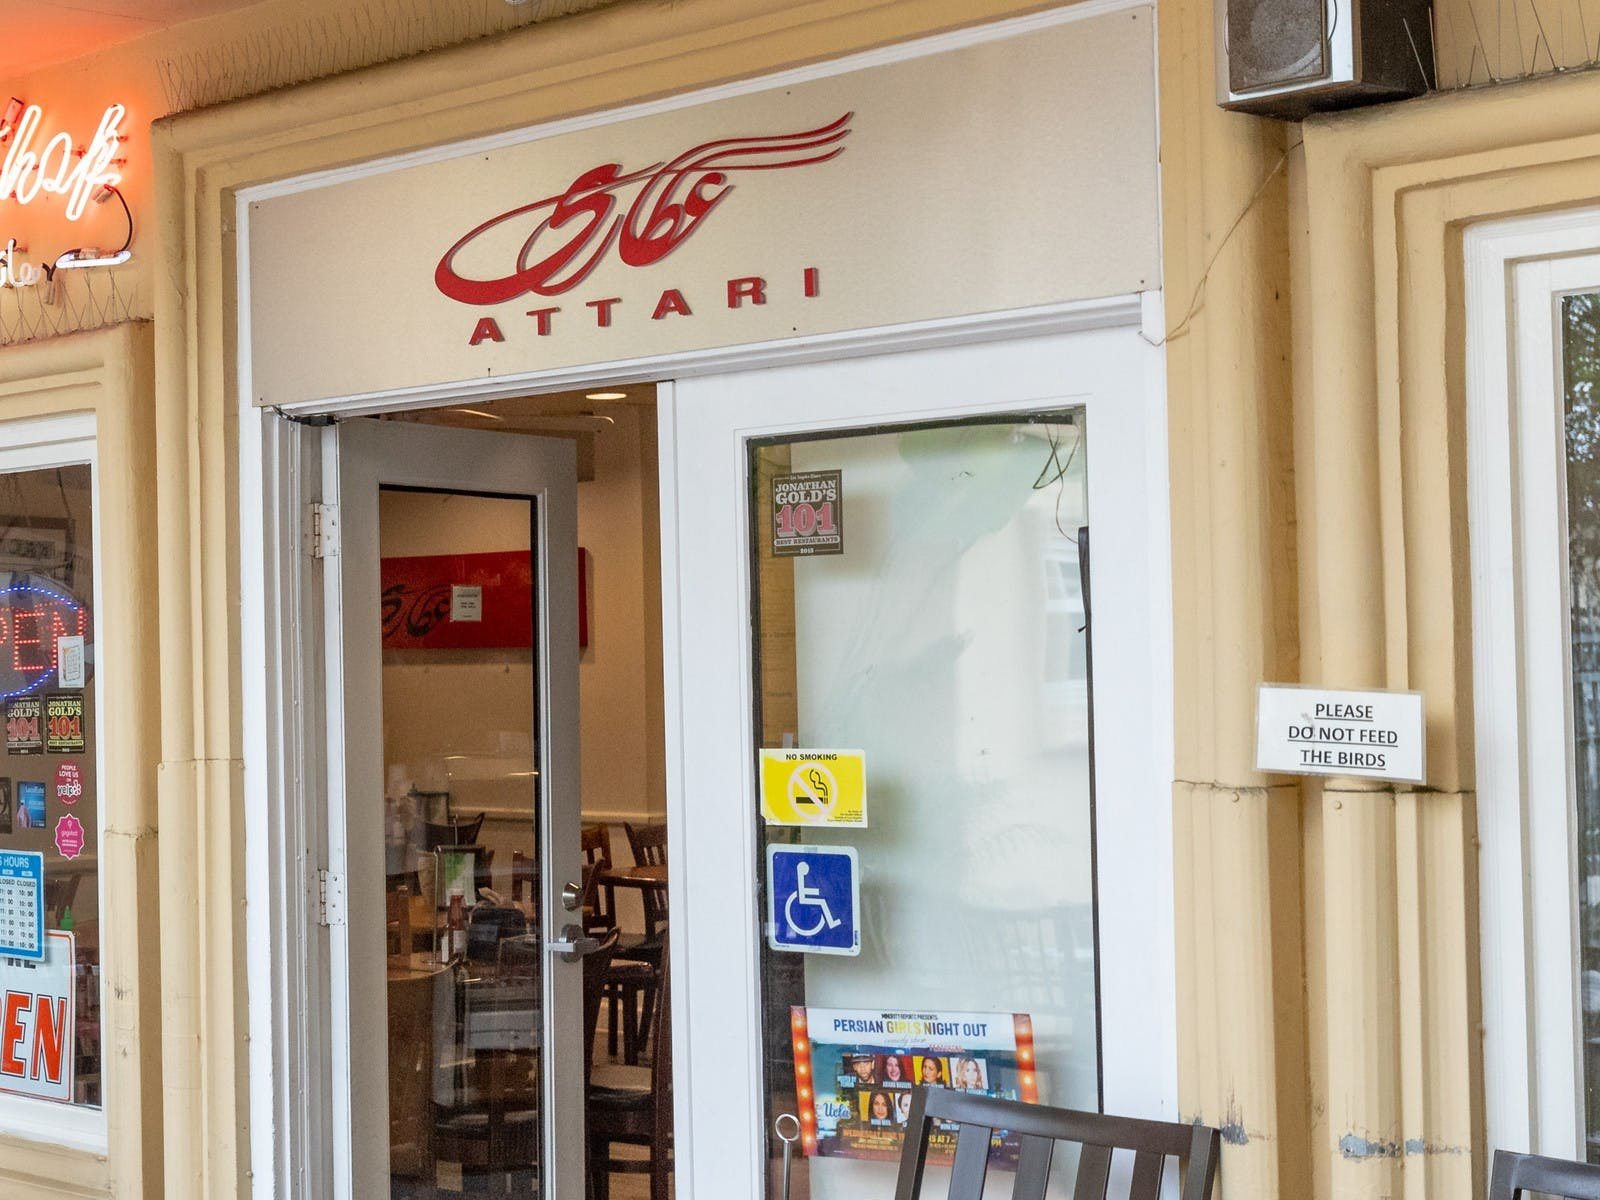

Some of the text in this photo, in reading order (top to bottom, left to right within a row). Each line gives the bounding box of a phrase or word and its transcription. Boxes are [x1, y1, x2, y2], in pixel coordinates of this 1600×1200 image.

[468, 267, 819, 346] ATTARI
[776, 480, 836, 492] JONATHAN
[776, 489, 837, 504] GOLD'S
[776, 501, 837, 537] 101
[8, 708, 40, 718] GOLD'S
[48, 706, 82, 716] GOLD'S
[1315, 703, 1374, 719] PLEASE
[7, 717, 40, 741] 101
[49, 716, 82, 740] 101
[1288, 725, 1398, 744] DO NOT FEED
[1300, 750, 1386, 767] THE BIRDS
[4, 856, 30, 868] HOURS
[834, 1018, 988, 1037] PERSIAN GIRLS NIGHT OUT
